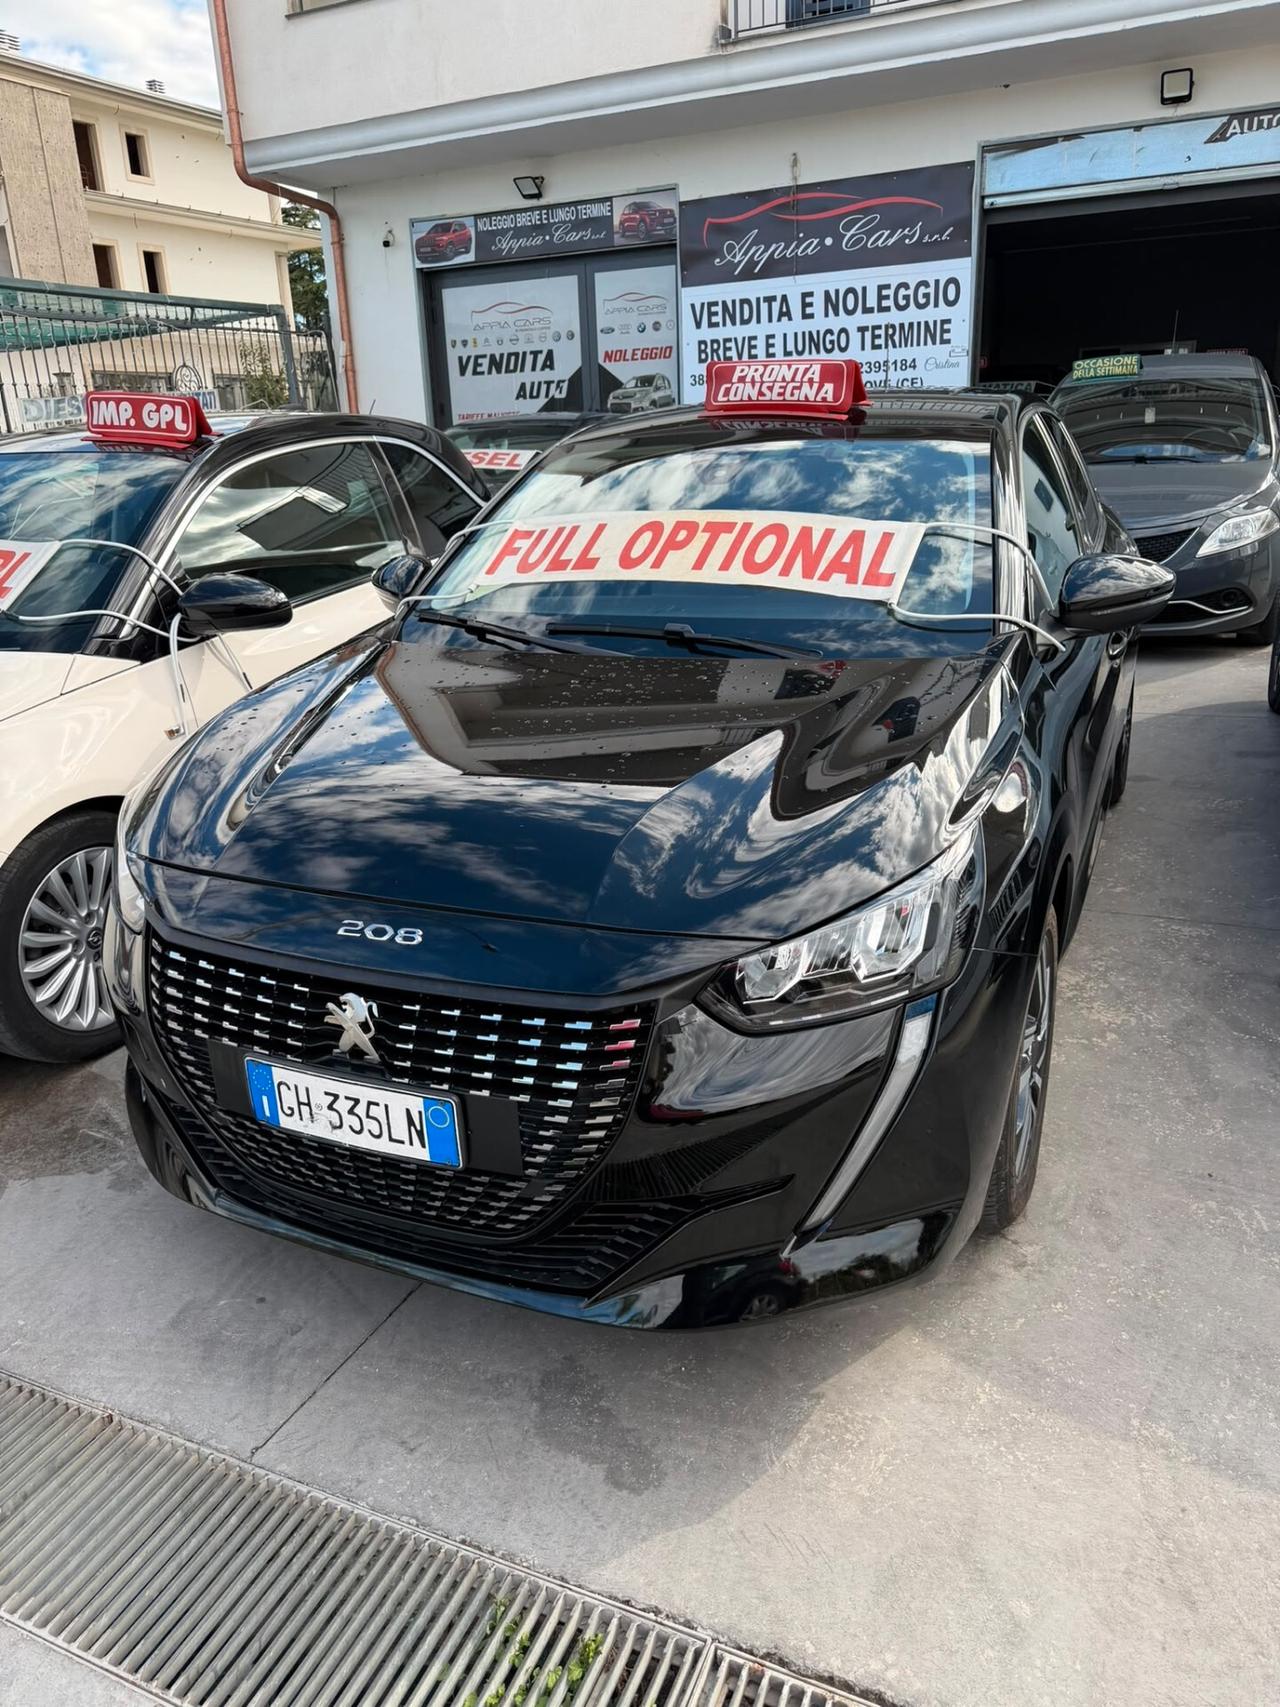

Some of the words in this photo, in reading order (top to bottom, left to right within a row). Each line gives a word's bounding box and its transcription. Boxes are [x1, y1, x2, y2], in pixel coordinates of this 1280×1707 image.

[477, 214, 515, 232] NOLEGGIO
[516, 210, 541, 226] BREVE
[541, 209, 548, 224] E
[548, 206, 576, 223] LUNGO
[577, 201, 611, 219] TERMINE
[491, 230, 545, 256] Appia
[552, 223, 592, 244] Cars
[714, 229, 822, 275] Appia
[839, 214, 922, 251] Cars
[690, 294, 793, 330] VENDITA
[801, 291, 815, 320] E
[824, 276, 961, 318] NOLEGGIO
[513, 316, 552, 328] CARS
[697, 334, 759, 364] BREVE
[765, 333, 776, 359] E
[783, 326, 850, 357] LUNGO
[857, 318, 952, 351] TERMINE
[458, 349, 555, 377] VENDITA
[603, 345, 673, 363] NOLEGGIO
[1074, 355, 1138, 370] OCCASIONE
[690, 373, 705, 386] 38
[731, 363, 821, 383] PRONTA
[1072, 366, 1095, 379] DELLA
[1096, 364, 1138, 377] SETTIMANA
[515, 379, 568, 401] AUTO
[717, 382, 834, 402] CONSEGNA
[92, 400, 135, 427] IMP.
[142, 402, 187, 431] GPL
[464, 451, 522, 467] SEL
[485, 522, 607, 575] FULL
[618, 520, 897, 588] OPTIONAL
[336, 919, 423, 945] 208
